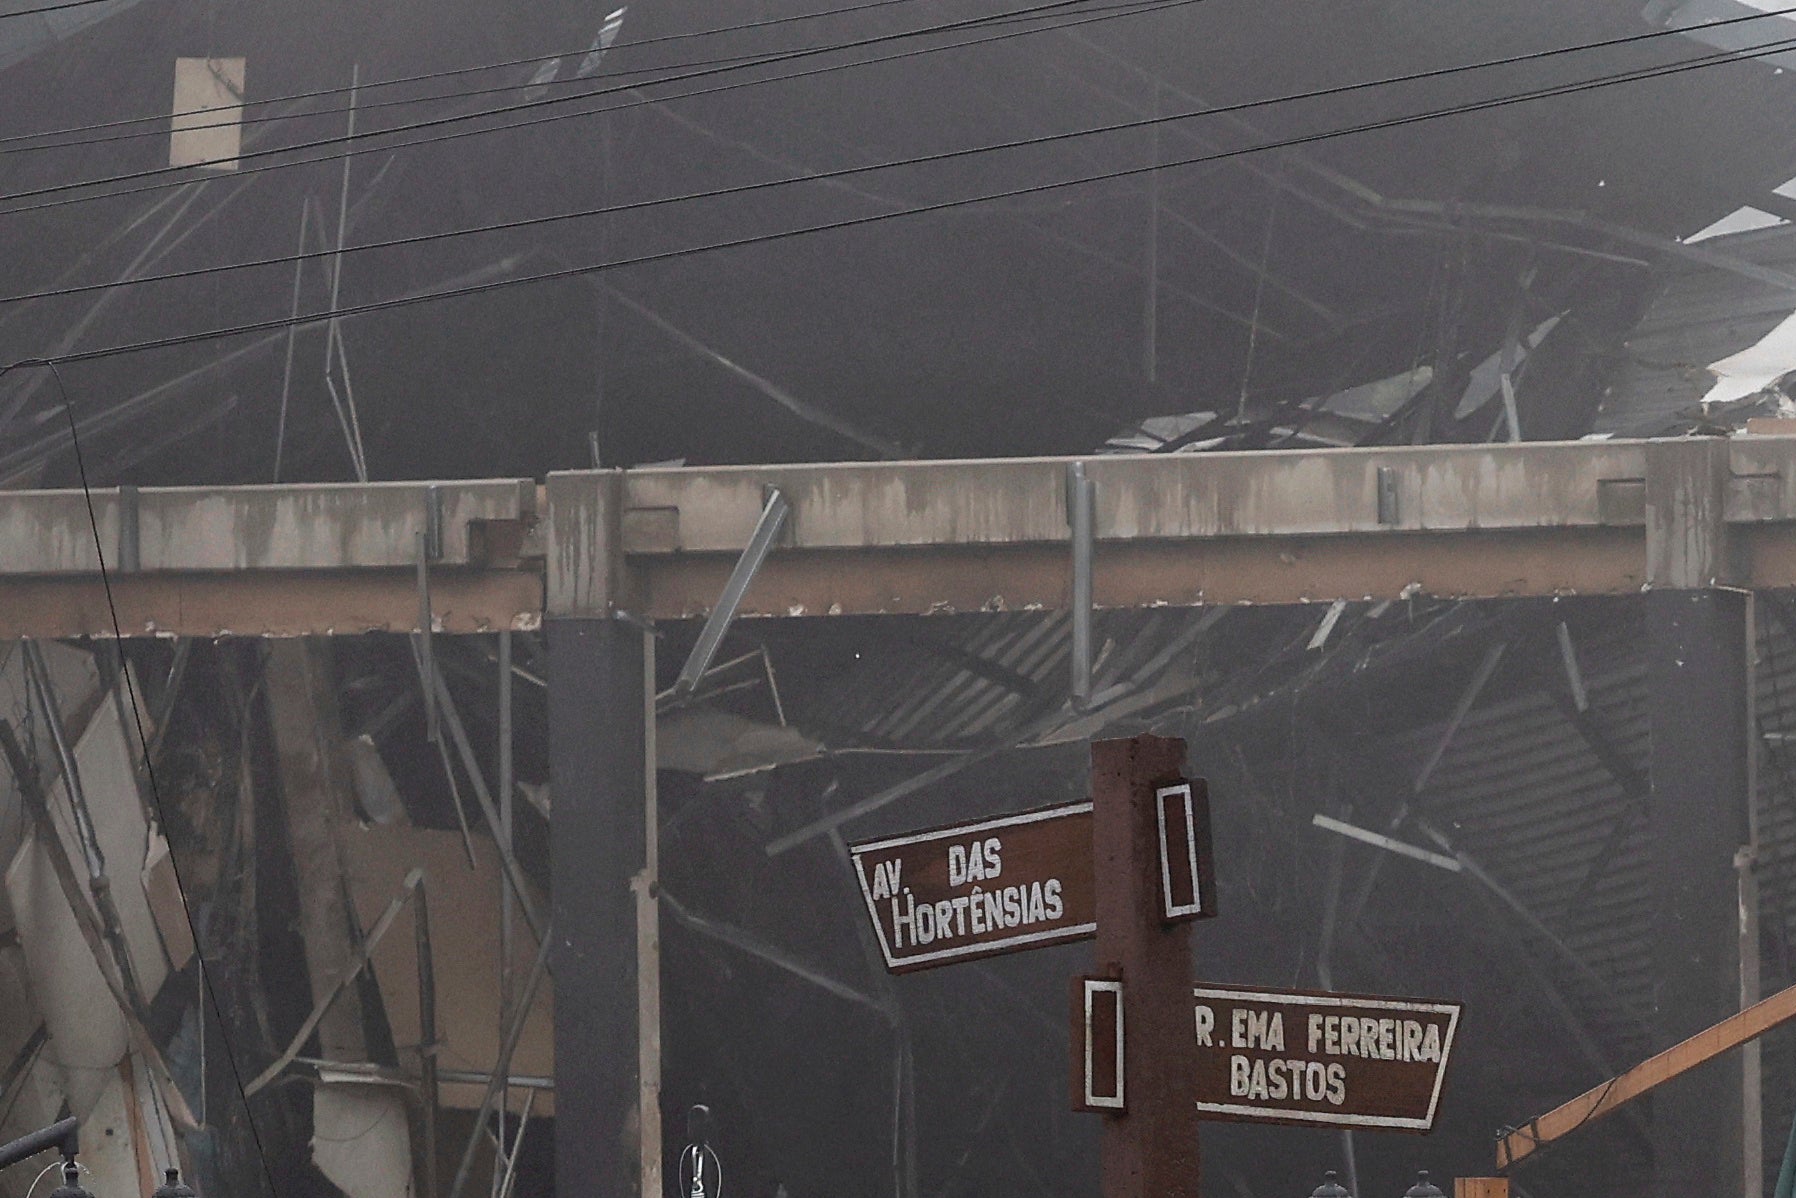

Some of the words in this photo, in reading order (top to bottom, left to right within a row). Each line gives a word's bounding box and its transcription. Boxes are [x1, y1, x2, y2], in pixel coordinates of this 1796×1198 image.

[872, 857, 910, 902] AV.
[948, 836, 1002, 886] DAS
[893, 877, 1064, 949] HORTÊNSIAS
[1194, 1005, 1226, 1049] R.
[1232, 1008, 1285, 1052] EMA
[1307, 1012, 1442, 1064] FERREIRA
[1230, 1058, 1347, 1106] BASTOS
